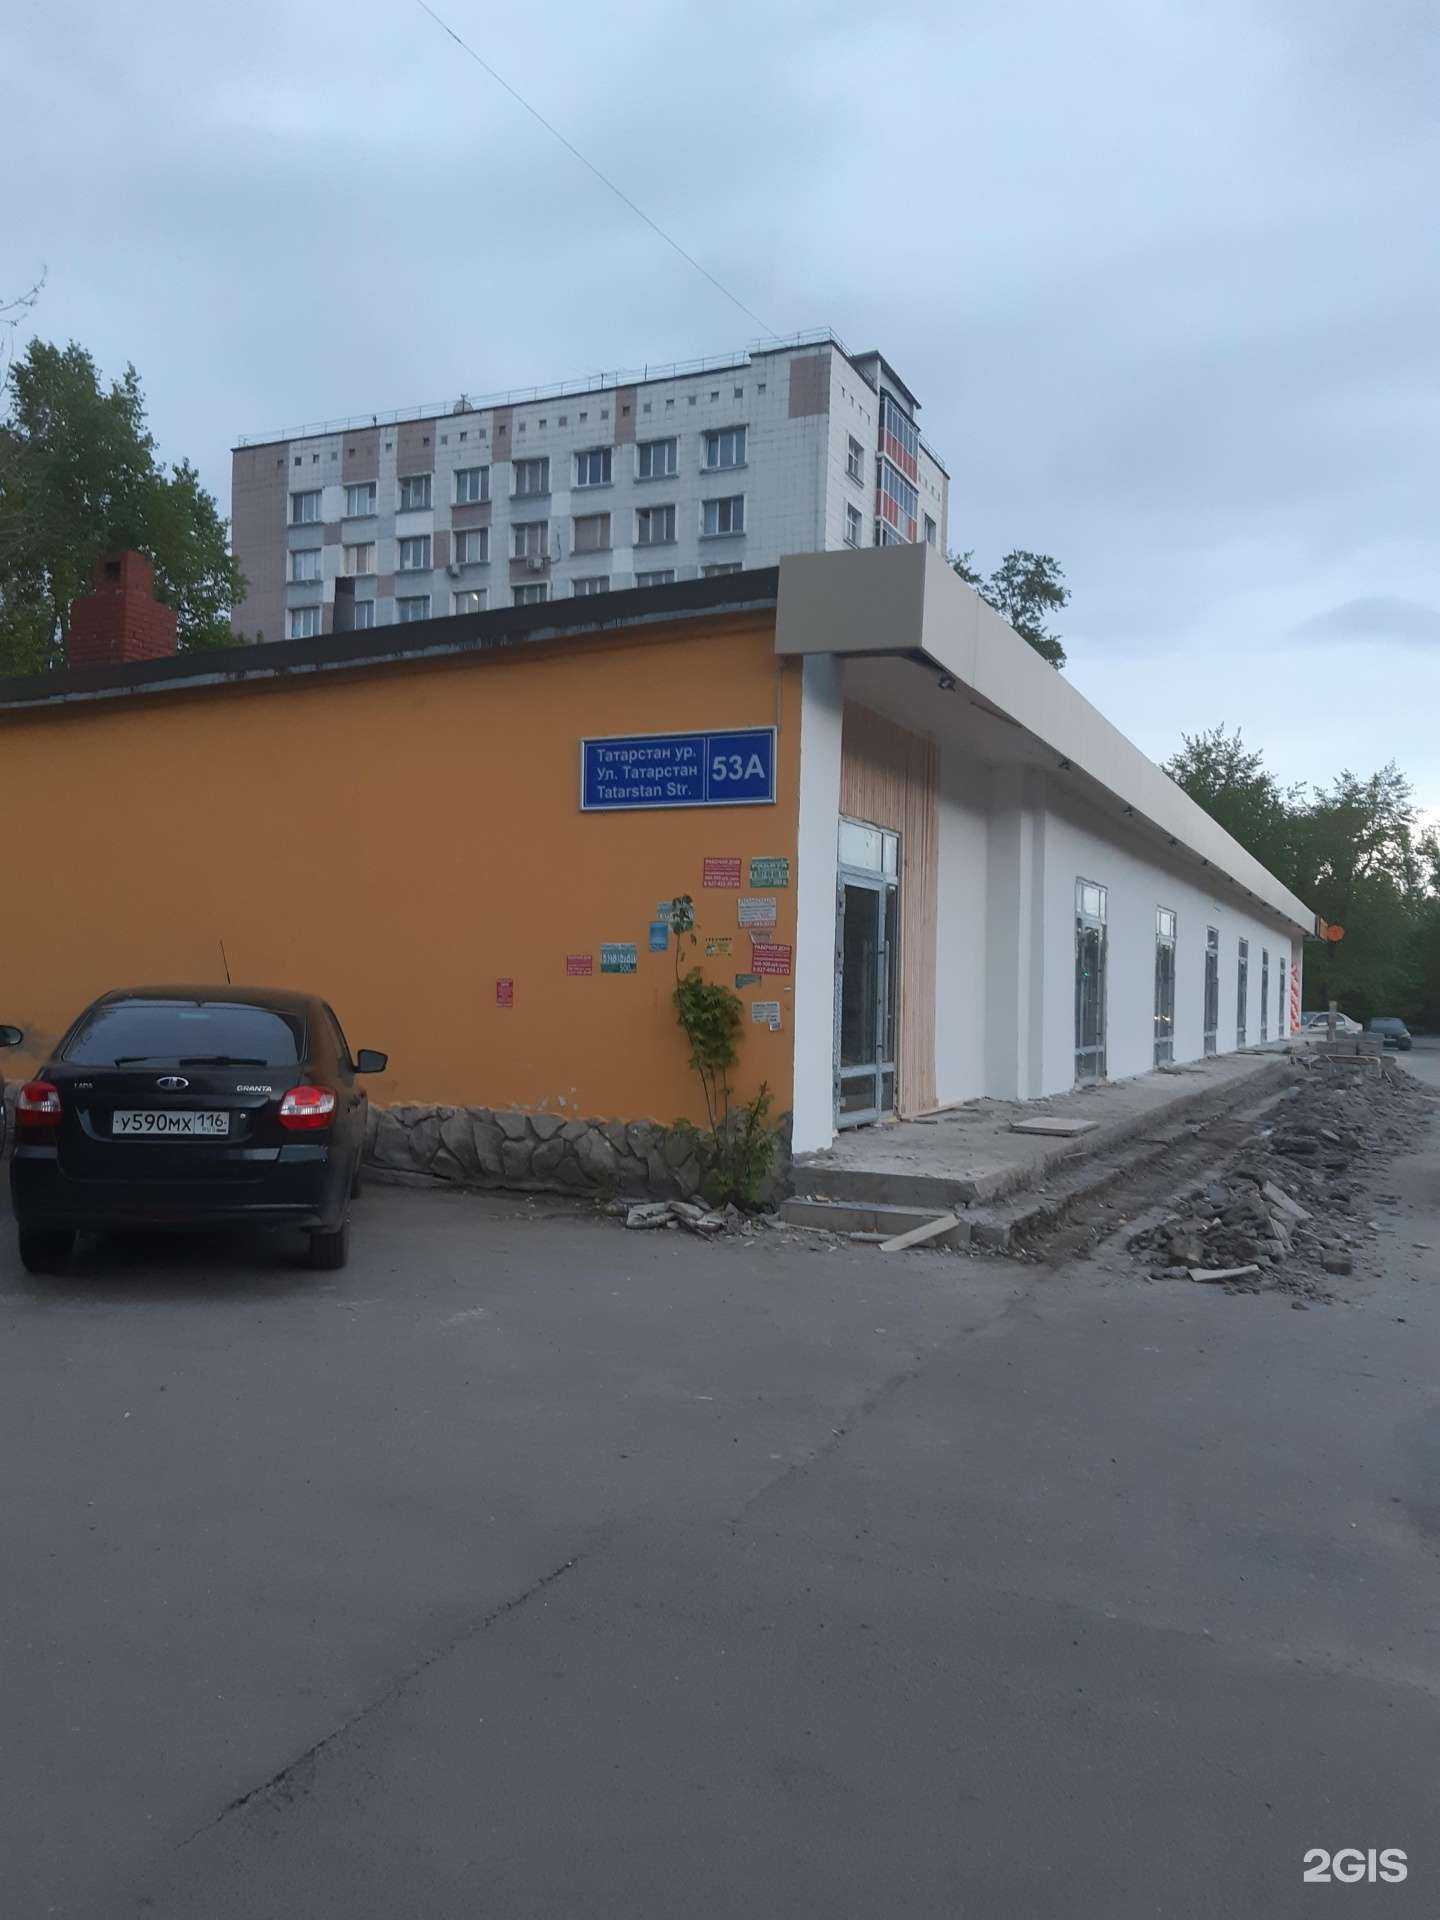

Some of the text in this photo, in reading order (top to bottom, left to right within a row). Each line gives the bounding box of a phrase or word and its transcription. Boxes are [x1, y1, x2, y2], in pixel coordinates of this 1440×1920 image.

[598, 746, 697, 764] Татарстан ур.
[597, 765, 698, 781] Ул. Татарстан
[711, 754, 766, 781] 53А
[598, 781, 692, 800] Tatarstan Str.
[236, 1084, 272, 1093] GRANTA
